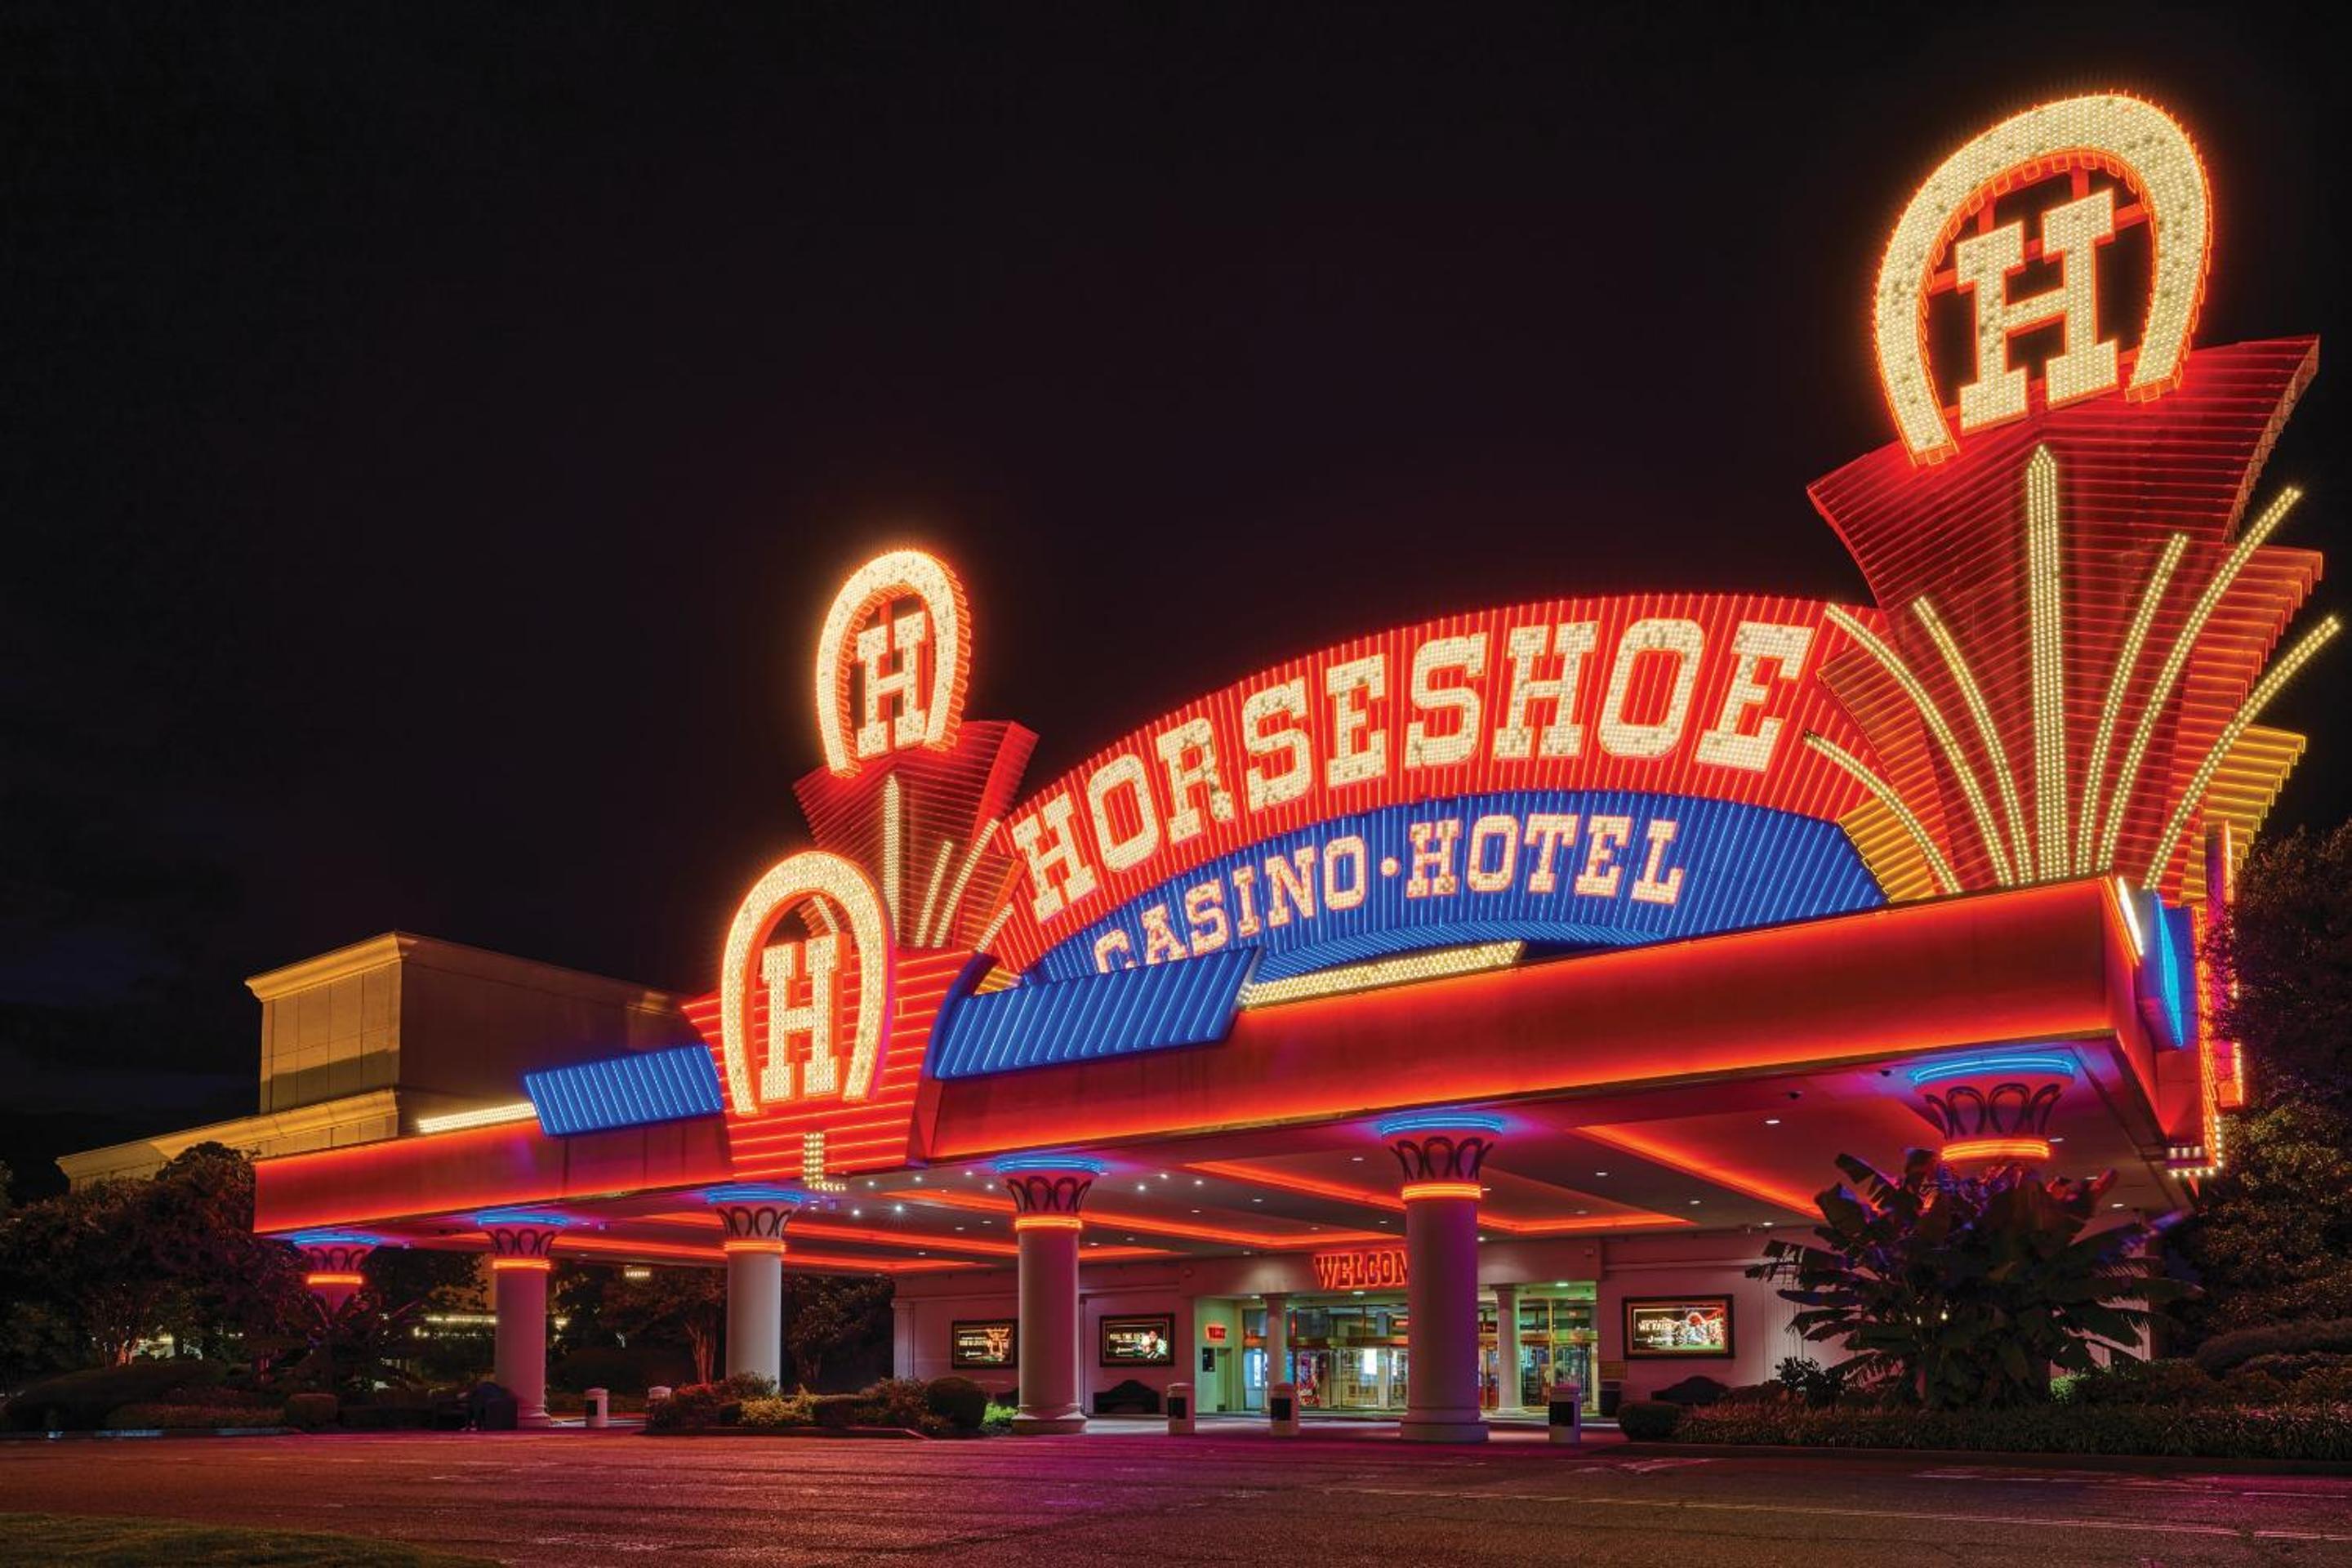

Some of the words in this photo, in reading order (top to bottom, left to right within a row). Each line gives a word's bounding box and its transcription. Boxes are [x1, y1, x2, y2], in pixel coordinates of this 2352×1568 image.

[1955, 187, 2120, 432] H
[857, 610, 928, 760] H
[1012, 617, 1815, 923] HORSESHOE
[1405, 813, 1685, 905] HOTEL
[760, 933, 840, 1101] H
